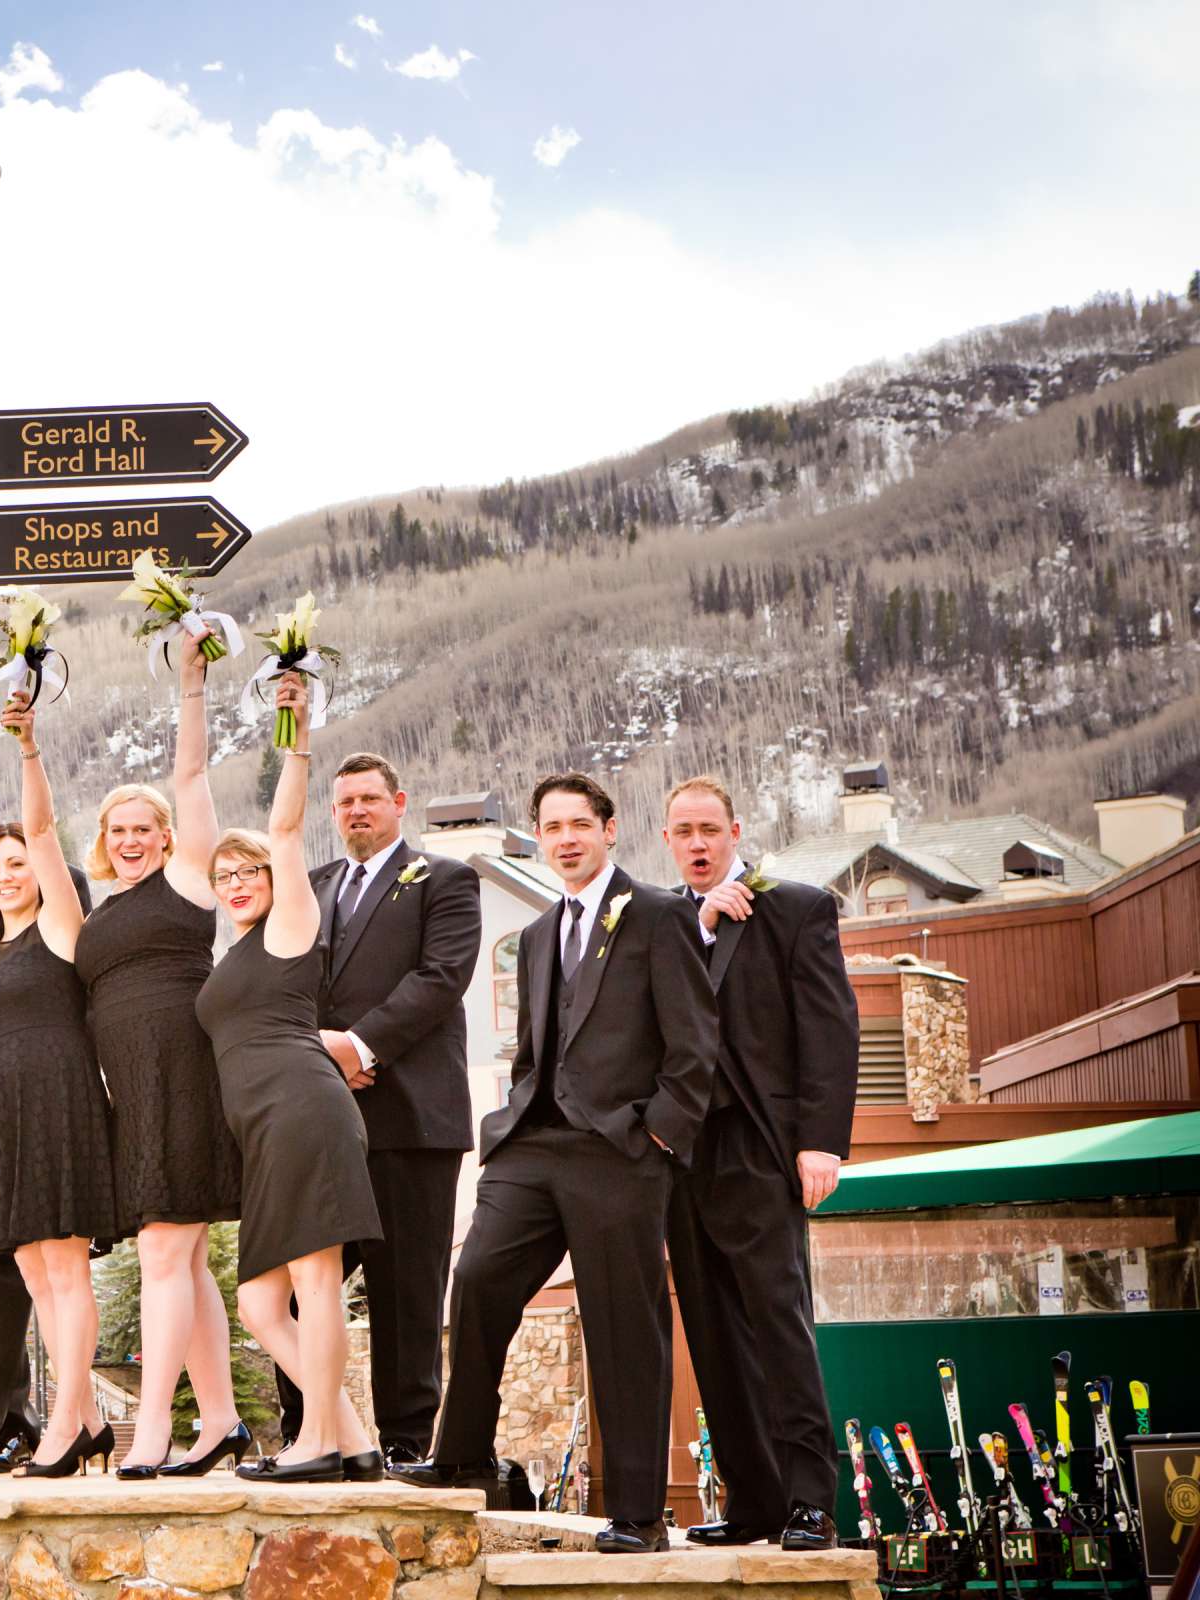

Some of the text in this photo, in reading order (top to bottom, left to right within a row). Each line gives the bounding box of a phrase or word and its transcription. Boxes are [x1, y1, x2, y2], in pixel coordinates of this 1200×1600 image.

[21, 418, 147, 446] Gerald R.
[23, 446, 145, 475] Ford Hall
[25, 512, 159, 547] Shops and
[896, 1544, 918, 1565] EF
[1001, 1538, 1033, 1560] GH
